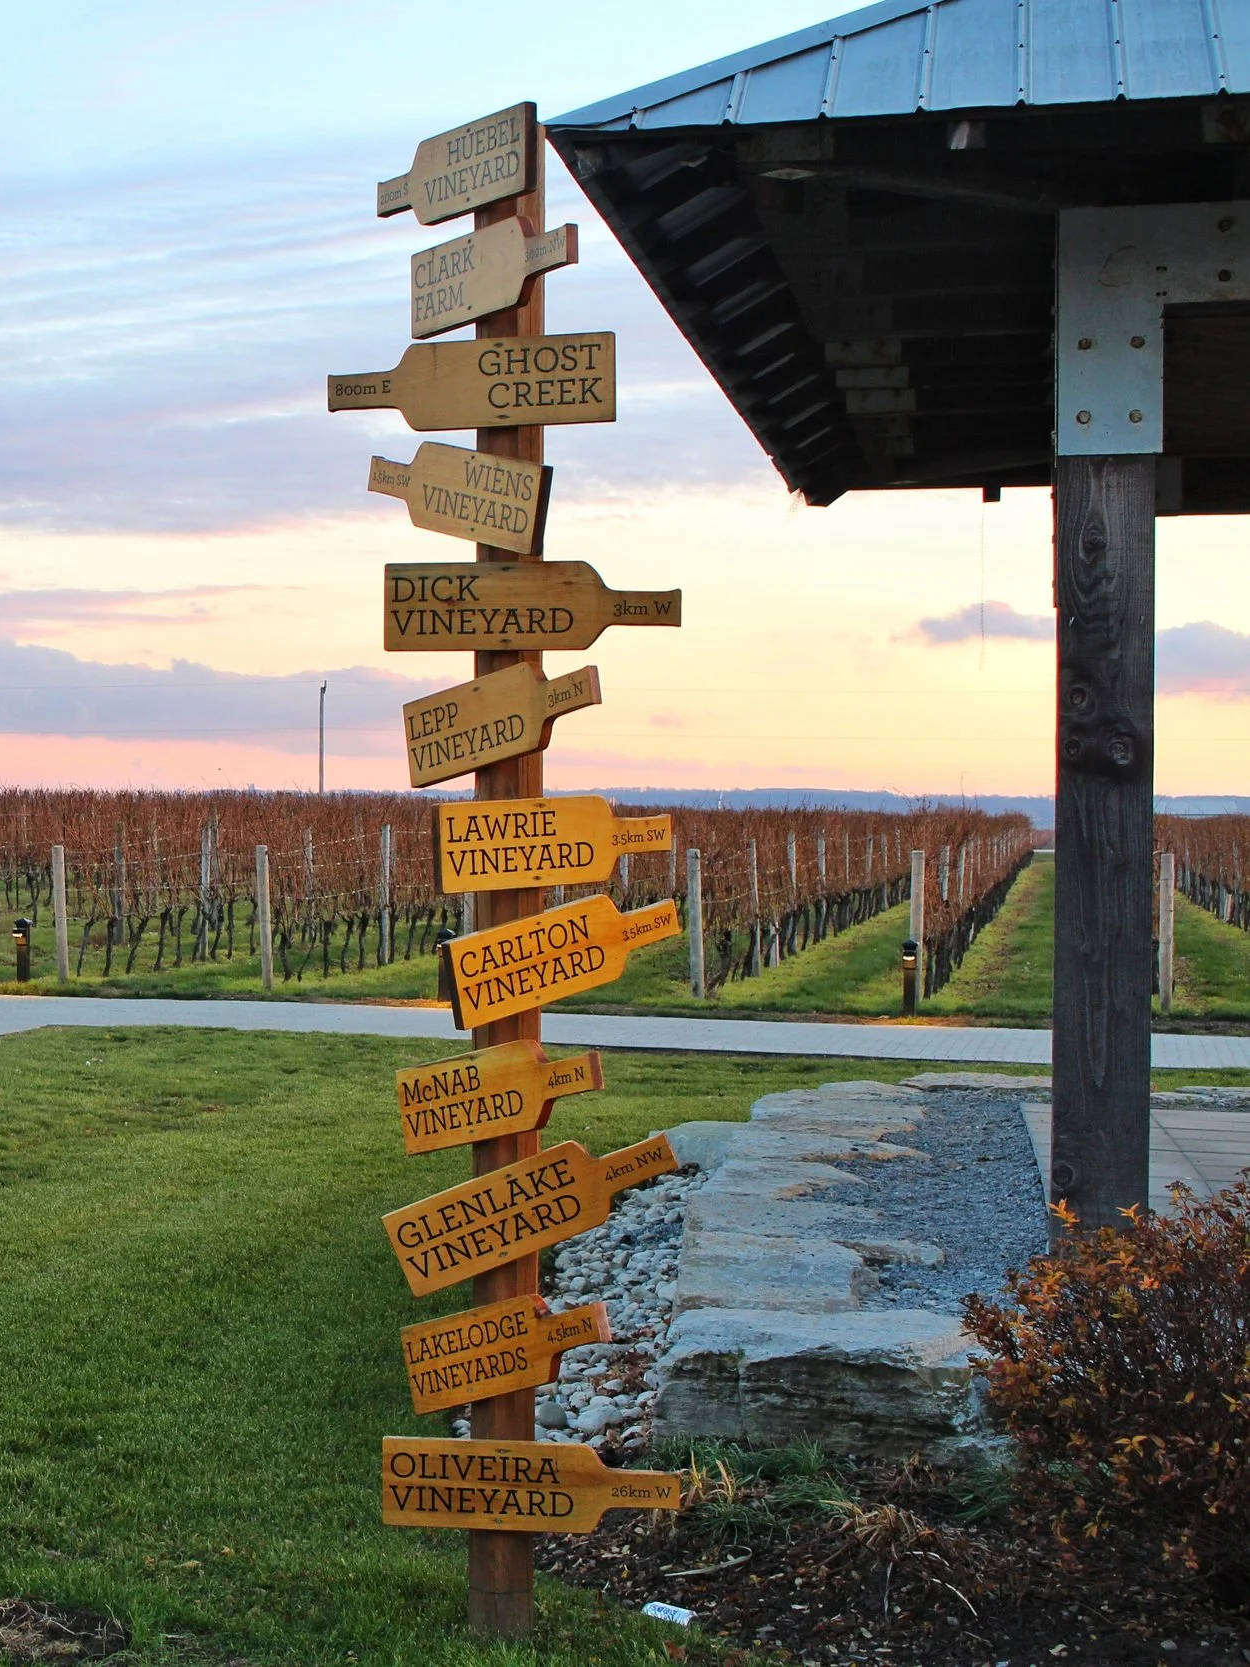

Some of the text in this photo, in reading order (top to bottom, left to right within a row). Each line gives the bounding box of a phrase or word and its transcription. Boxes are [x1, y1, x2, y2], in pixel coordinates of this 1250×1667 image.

[447, 117, 520, 167] HUEBEL
[403, 183, 409, 196] S
[424, 150, 520, 205] VINEYARD
[414, 244, 475, 289] CLARK
[414, 282, 464, 322] FARM
[478, 344, 601, 376] GHOST
[335, 381, 391, 397] 800m E
[488, 377, 603, 408] CREEK
[396, 474, 411, 487] SW
[464, 461, 534, 502] WIENS
[422, 484, 528, 534] VINEYARD
[391, 575, 480, 602] DICK
[391, 608, 574, 636] VINEYARD
[613, 600, 672, 617] 3km W
[547, 681, 584, 708] 3km N
[408, 702, 458, 740] LEPP
[411, 714, 524, 772] VINEYARD
[446, 811, 557, 843] LAWRIE
[612, 829, 666, 846] 3.5km SW
[447, 842, 594, 877] VINEYARD
[653, 914, 671, 929] SW
[460, 915, 589, 978] CARLTON
[463, 945, 605, 1011] VINEYARD
[402, 1065, 481, 1107] McNAB
[547, 1066, 584, 1089] 4km N
[406, 1089, 523, 1138] VINEYARD
[605, 1147, 663, 1183] 4km NW
[396, 1158, 575, 1249] GLENLAKE
[405, 1194, 581, 1279] VINEYARD
[406, 1311, 528, 1365] LAKELODGE
[547, 1317, 593, 1344] 4.5km N
[411, 1347, 528, 1397] VINEYARDS
[390, 1452, 560, 1484] OLIVEIRA
[389, 1485, 574, 1517] VINEYARD
[611, 1484, 671, 1499] 26km W
